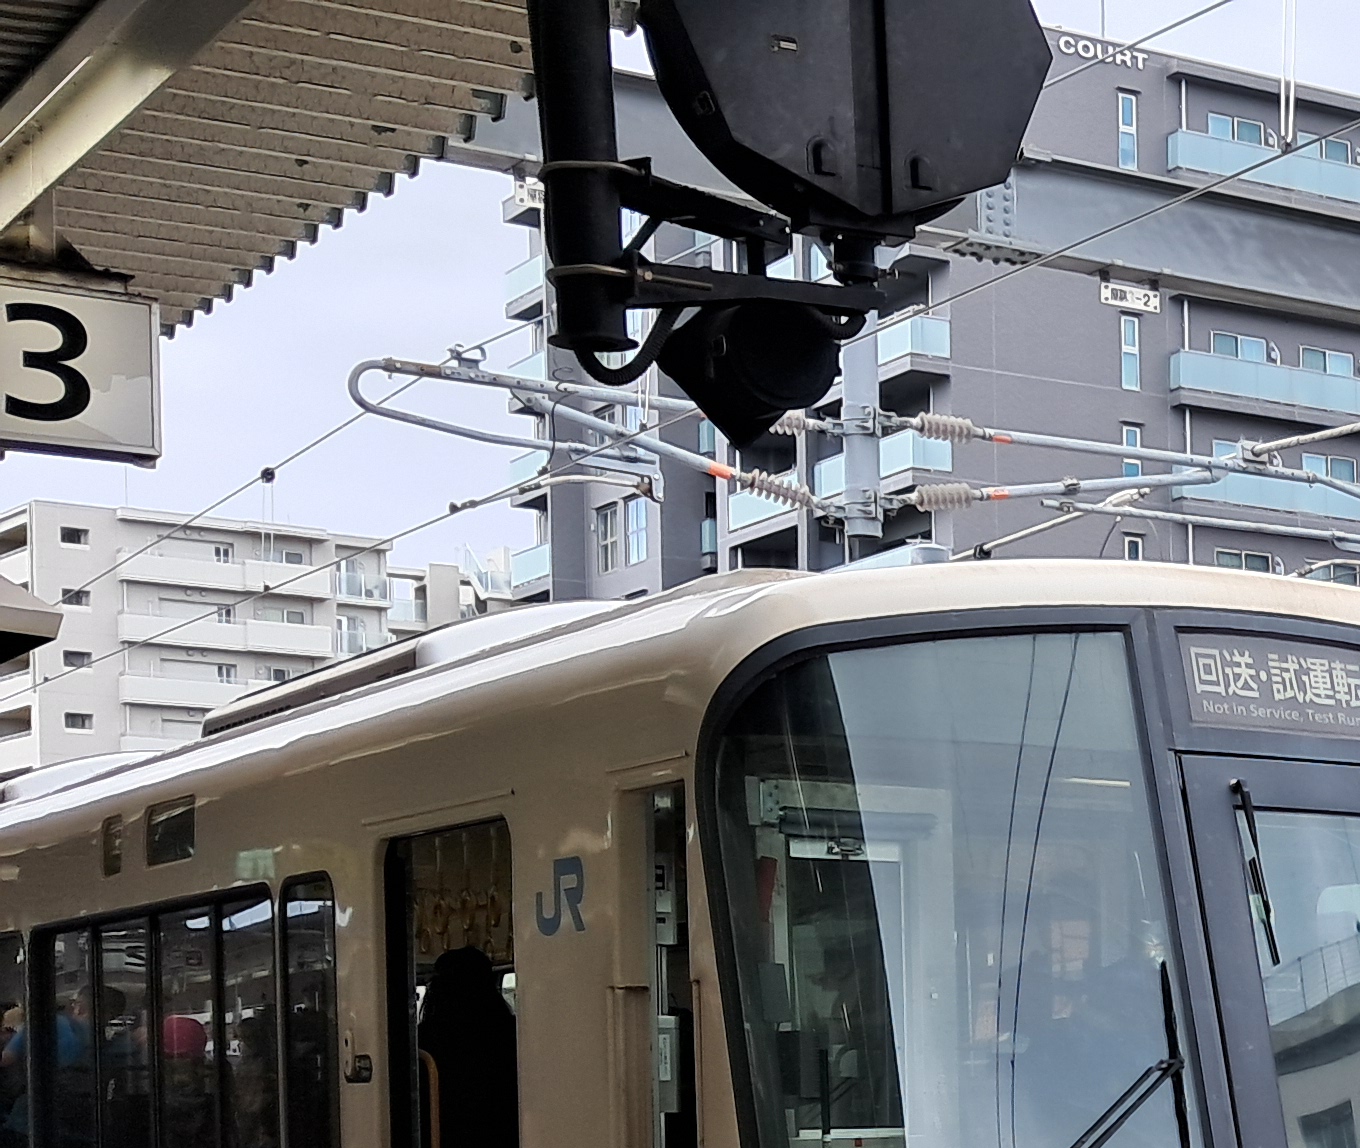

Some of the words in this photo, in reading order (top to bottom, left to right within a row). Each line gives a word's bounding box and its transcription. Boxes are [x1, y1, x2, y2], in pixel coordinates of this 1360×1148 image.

[1058, 35, 1149, 71] COURT
[5, 302, 91, 421] 3
[1202, 699, 1230, 715] Not
[1250, 704, 1303, 723] Service,
[1306, 709, 1335, 725] Test
[535, 855, 586, 937] JR
